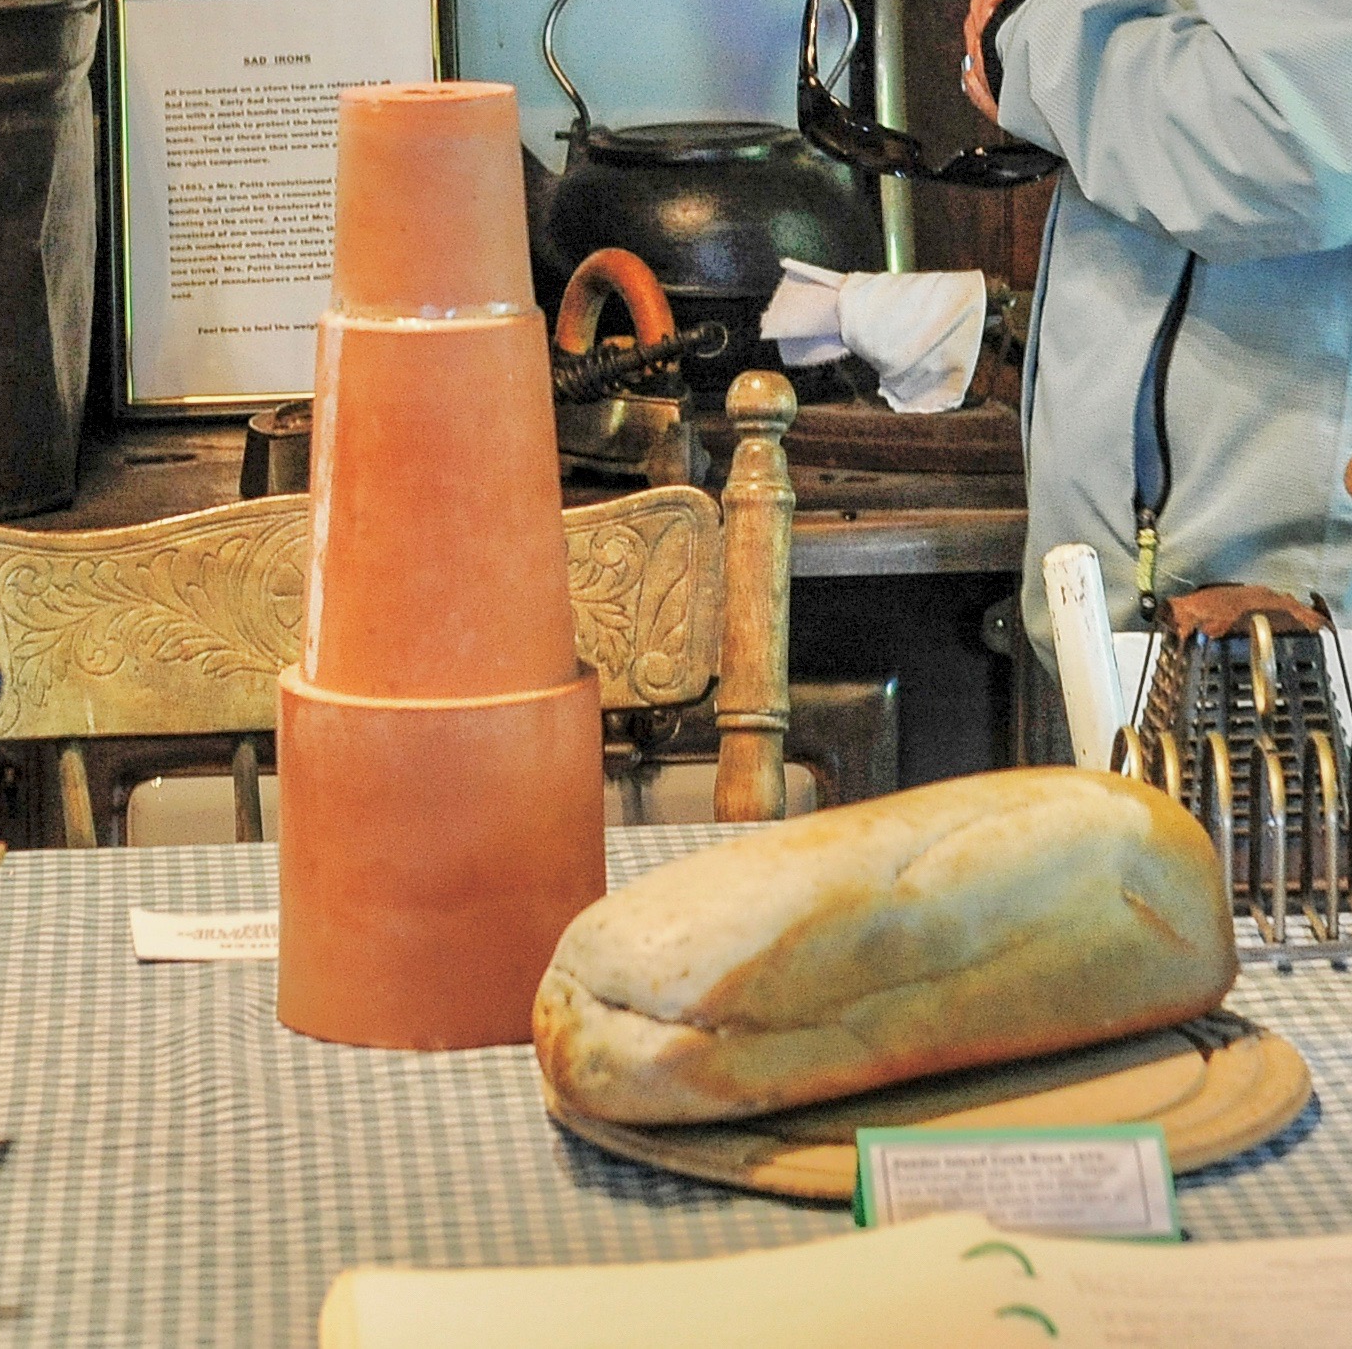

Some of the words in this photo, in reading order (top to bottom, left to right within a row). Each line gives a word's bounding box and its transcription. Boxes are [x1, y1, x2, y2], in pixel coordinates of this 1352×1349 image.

[243, 55, 266, 66] SAD
[274, 53, 310, 65] IRONS
[320, 93, 338, 102] mad
